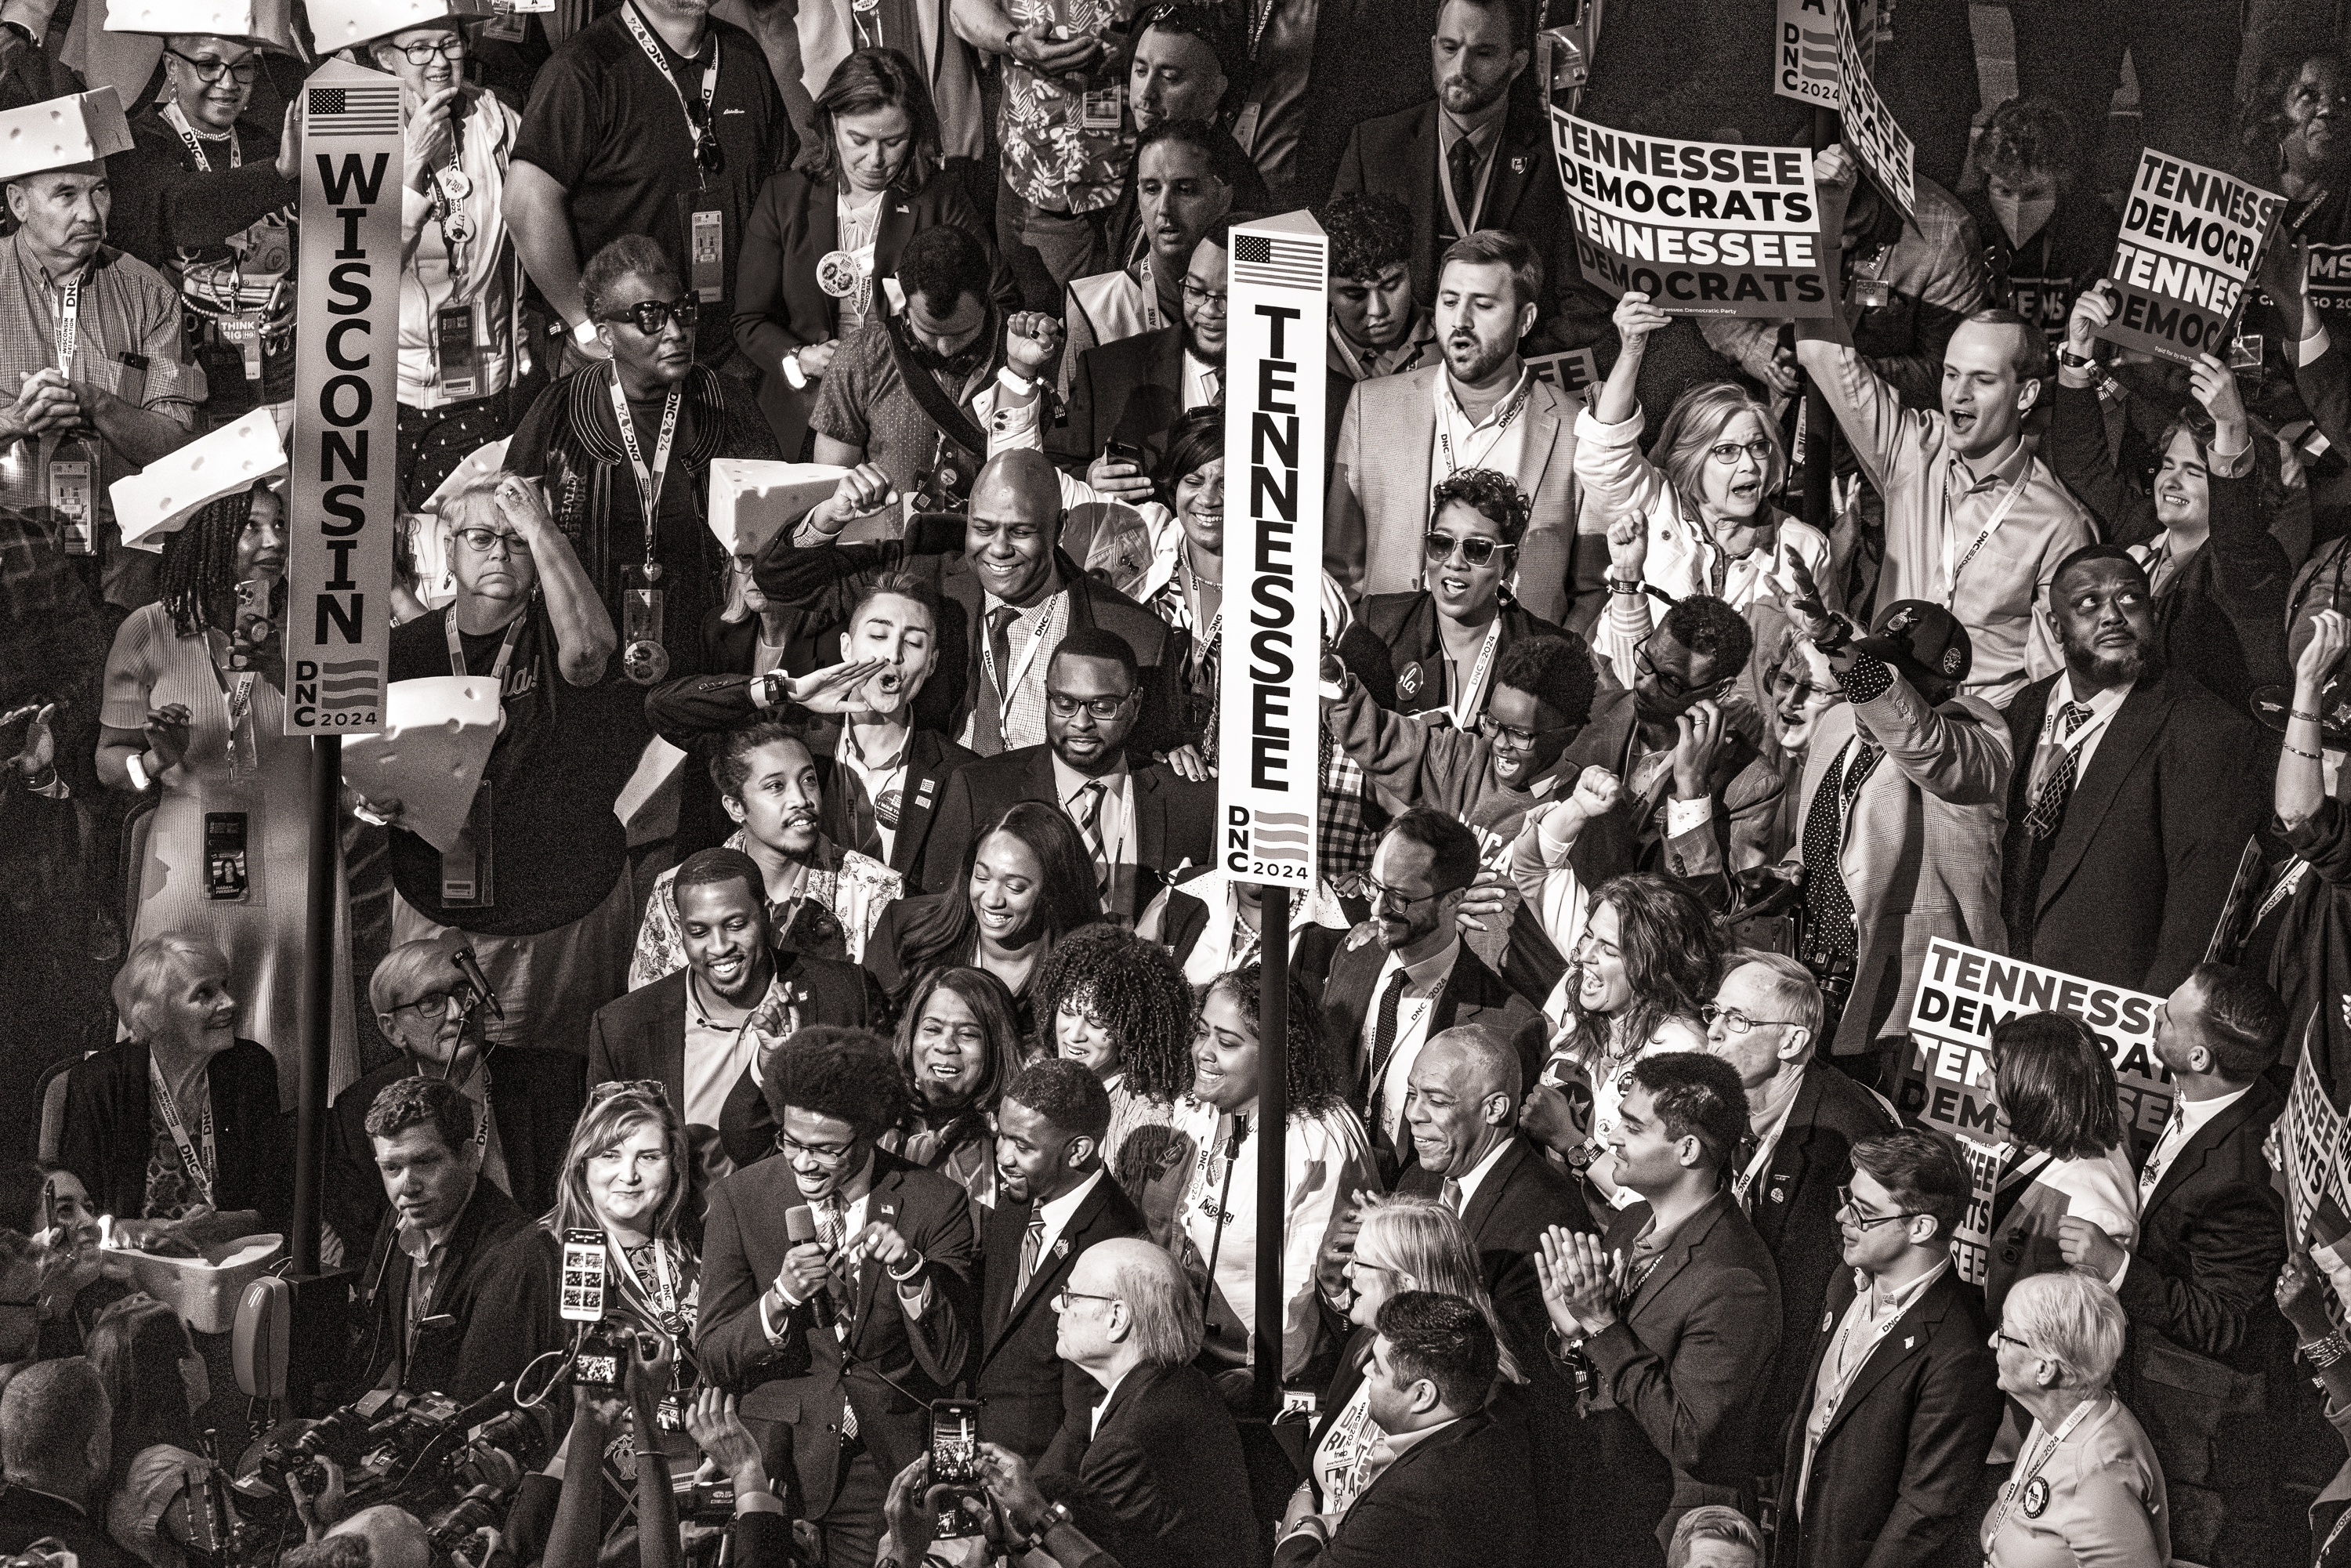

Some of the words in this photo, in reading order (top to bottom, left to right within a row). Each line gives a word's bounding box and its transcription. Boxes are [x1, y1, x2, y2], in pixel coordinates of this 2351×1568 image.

[1552, 111, 1806, 186] TENNESSEE
[1559, 153, 1813, 223] DEMOCRATS
[1569, 196, 1817, 267] TENNESSEE
[2125, 197, 2254, 271] DEMOCR
[1579, 240, 1825, 303] DEMOCRATS
[221, 321, 255, 331] THINK
[314, 153, 389, 645] WISCONSIN
[1440, 434, 1450, 454] DNC
[1250, 305, 1300, 791] TENNESSEE
[1048, 593, 1059, 612] 202
[1481, 636, 1495, 659] 2024
[293, 660, 318, 728] DNC
[321, 712, 379, 726] 2024
[1227, 806, 1249, 872] DNC
[1254, 862, 1309, 880] 2024
[1931, 943, 2153, 1034] TENNESS
[203, 1106, 212, 1135] DNC
[180, 1145, 200, 1174] DNC
[1197, 1150, 1209, 1170] DNC
[662, 1284, 672, 1301] DNC
[1355, 1402, 1366, 1422] DNC
